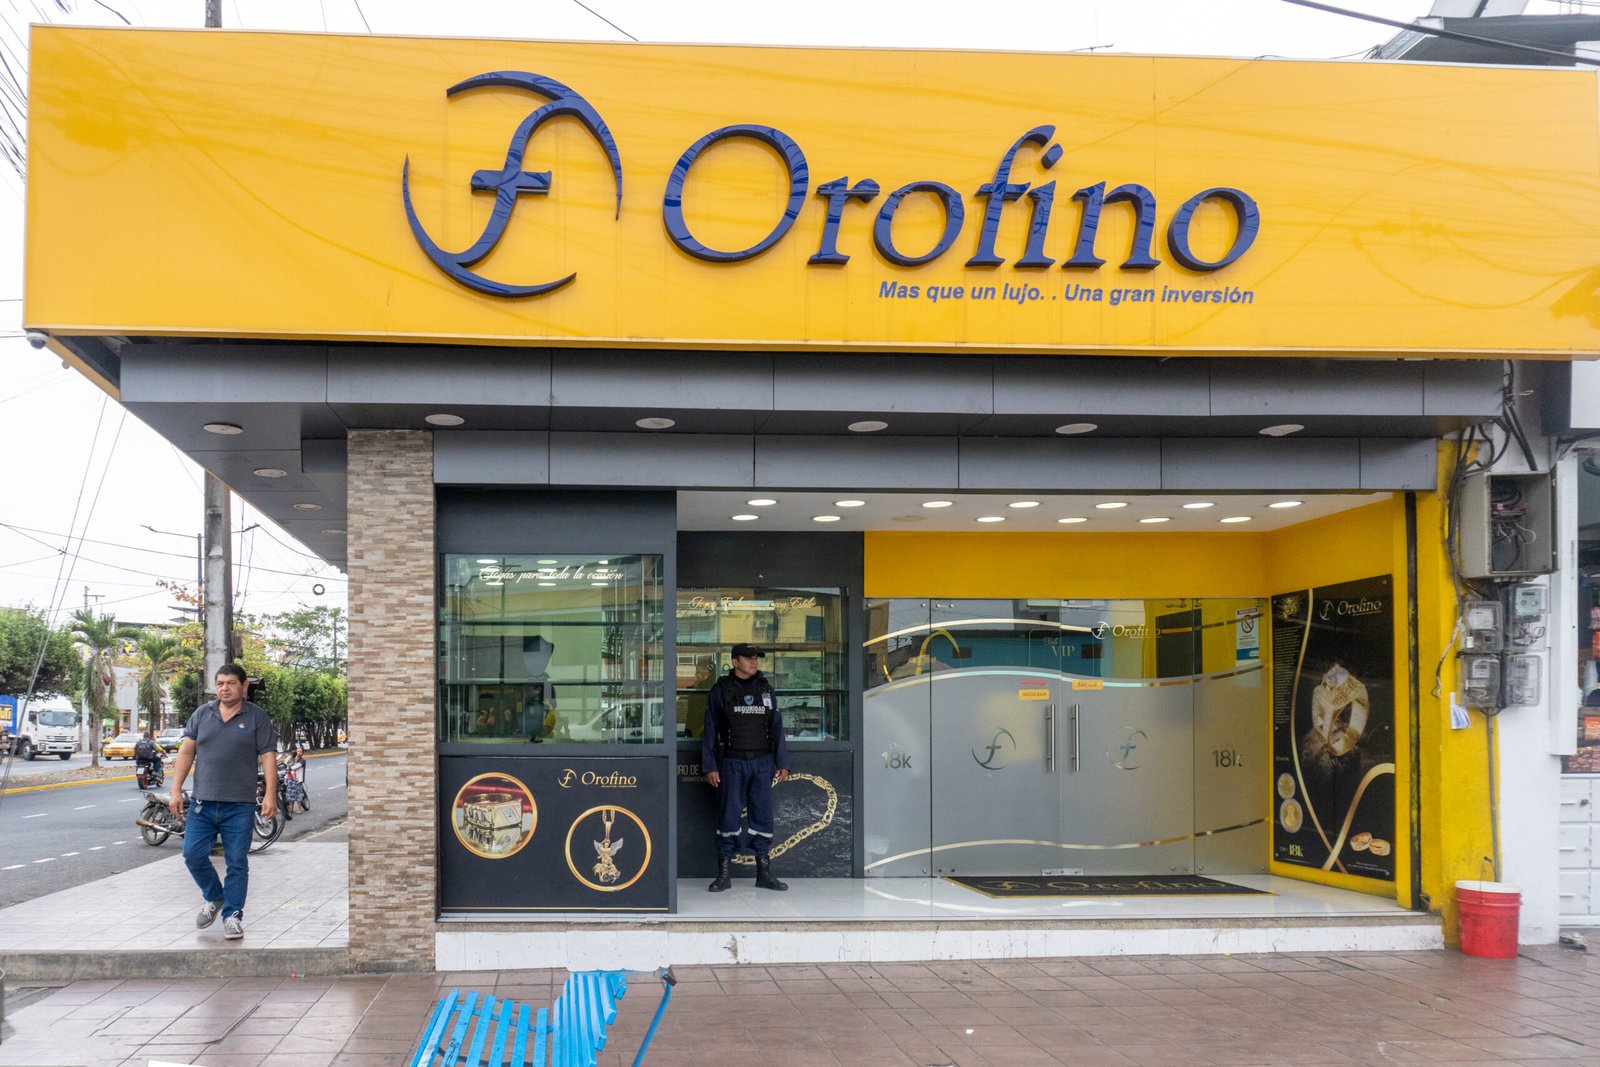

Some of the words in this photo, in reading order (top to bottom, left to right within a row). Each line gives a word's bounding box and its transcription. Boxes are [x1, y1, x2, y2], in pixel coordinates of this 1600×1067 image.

[663, 124, 1260, 272] Orofino
[879, 281, 920, 299] Mas
[926, 285, 965, 303] que
[971, 287, 997, 299] un
[1064, 284, 1103, 301] Una
[1109, 289, 1155, 306] gran
[1161, 283, 1255, 304] inversión
[516, 572, 545, 583] para
[573, 565, 585, 580] la
[1051, 645, 1076, 657] VIP
[733, 705, 766, 713] SEGURIDAD
[581, 770, 637, 785] Orofino
